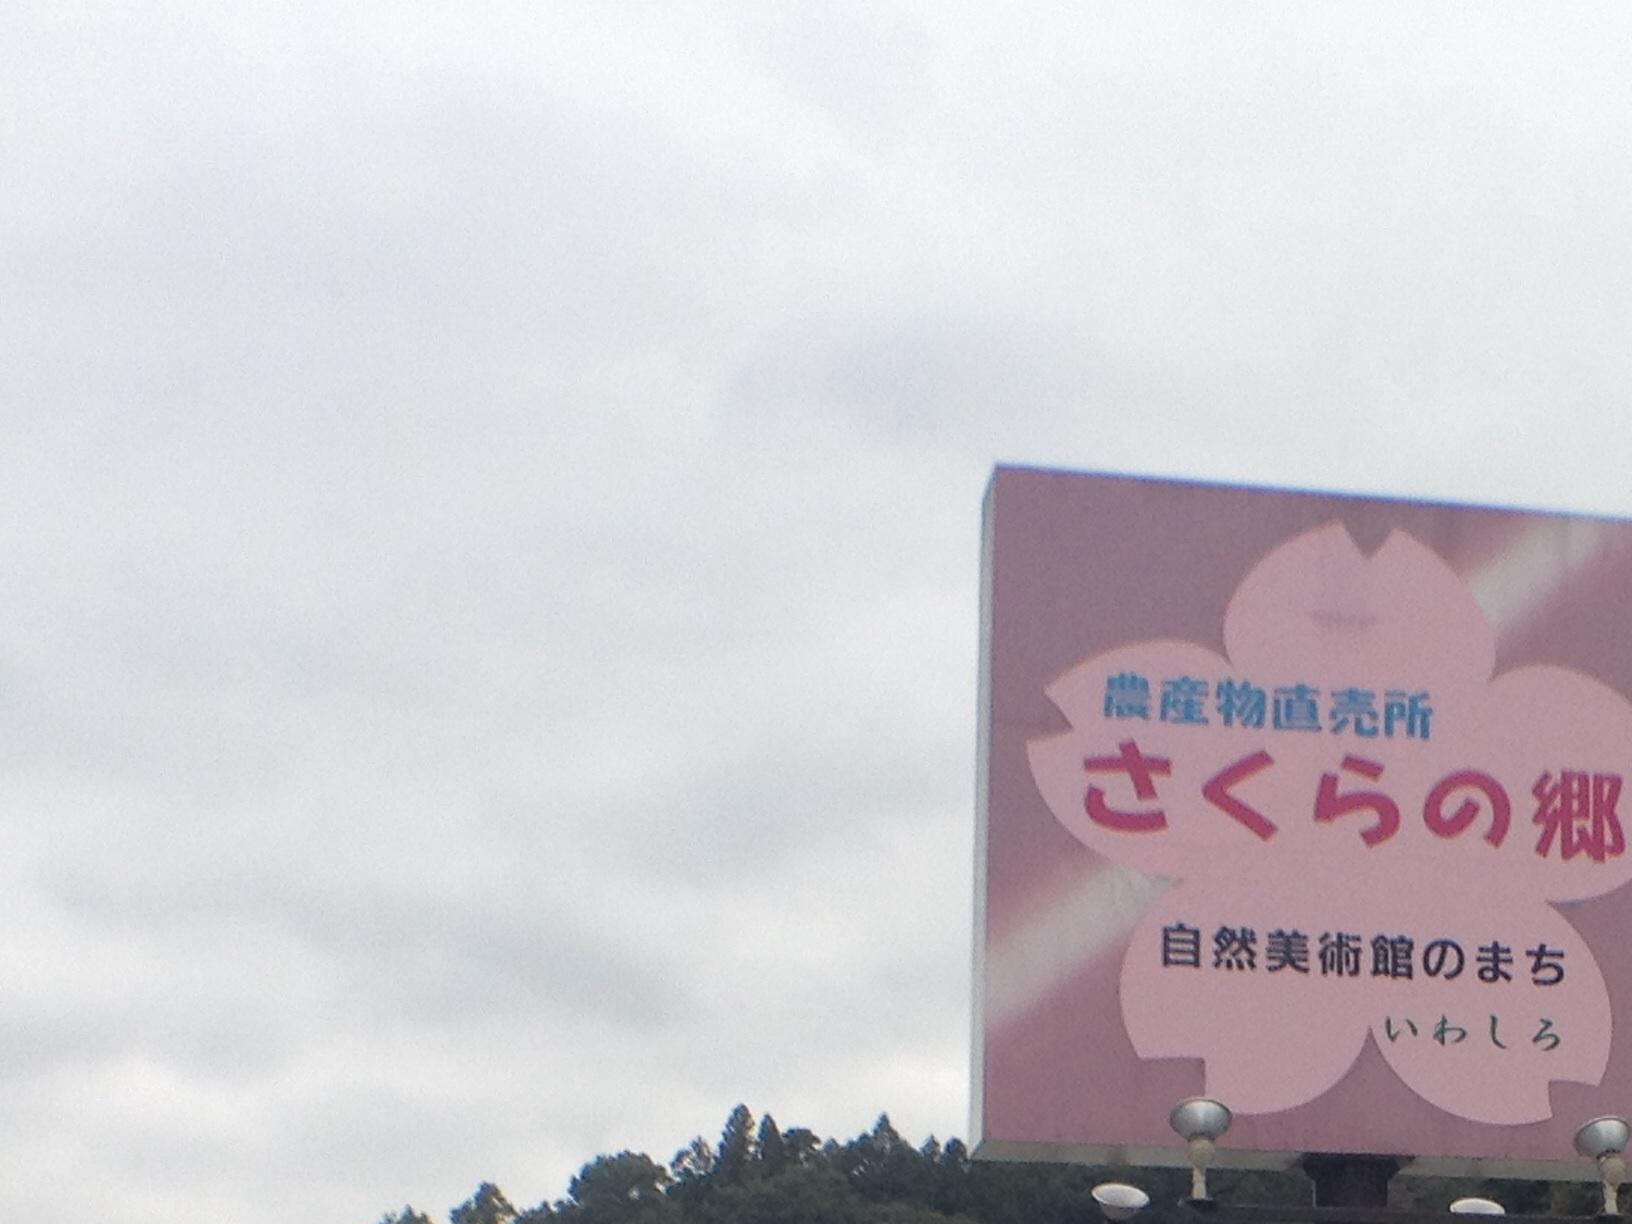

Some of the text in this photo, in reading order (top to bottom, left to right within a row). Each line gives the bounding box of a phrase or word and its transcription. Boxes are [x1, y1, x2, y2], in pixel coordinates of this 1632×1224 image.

[1103, 672, 1434, 740] 農産物直売所
[1082, 740, 1626, 864] さくらの郷
[1160, 923, 1566, 988] 自然美術館のまち
[1384, 1014, 1562, 1052] いわしろ
